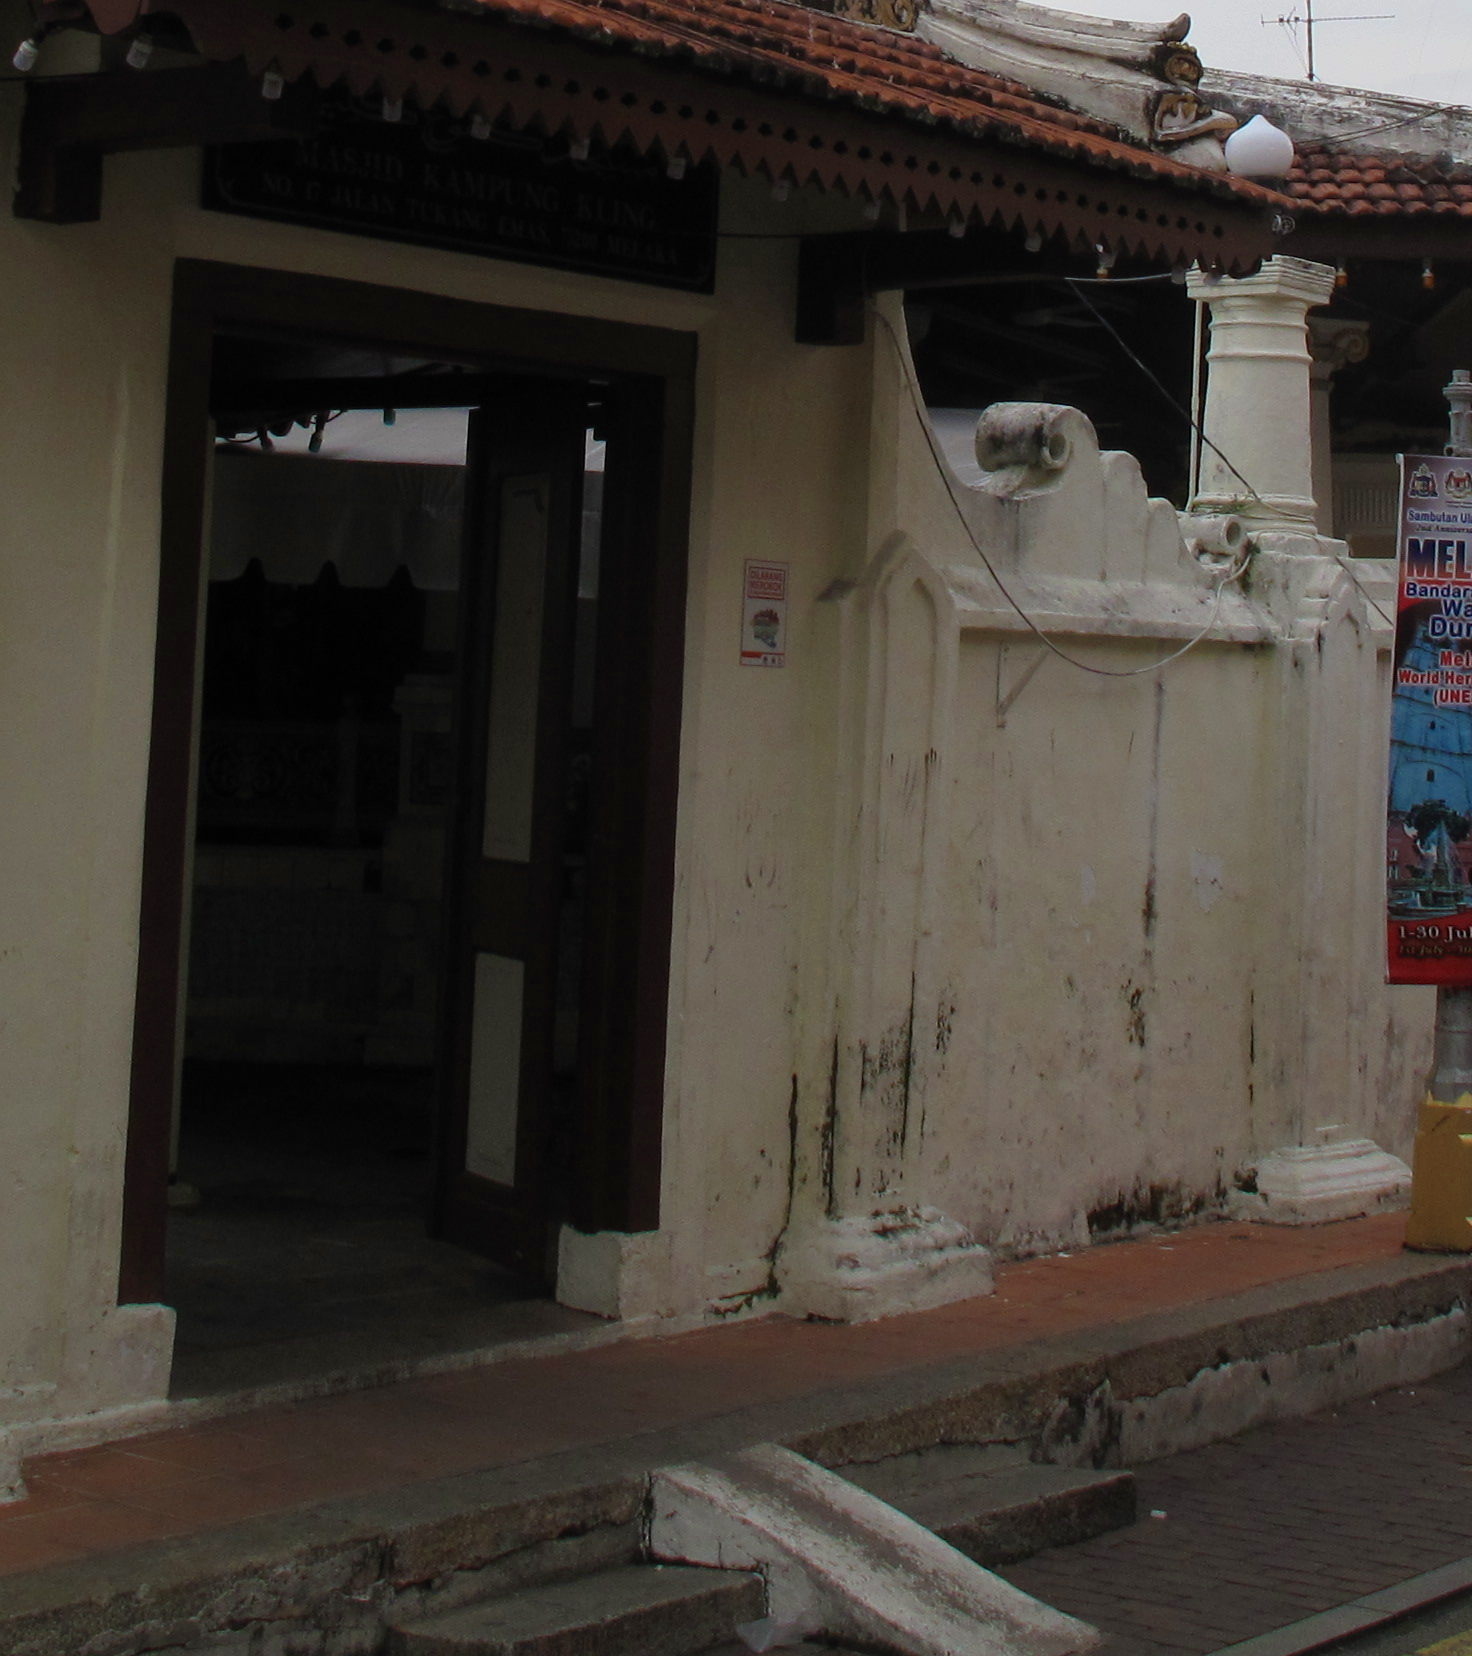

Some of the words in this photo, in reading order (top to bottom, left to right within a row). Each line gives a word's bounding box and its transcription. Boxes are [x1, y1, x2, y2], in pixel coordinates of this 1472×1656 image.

[423, 162, 561, 213] KAMPUNG
[328, 183, 396, 214] JALAN
[405, 198, 489, 233] TUKANG
[1408, 510, 1458, 524] Sambutan
[1399, 669, 1440, 684] World
[1399, 925, 1440, 939] 1-30
